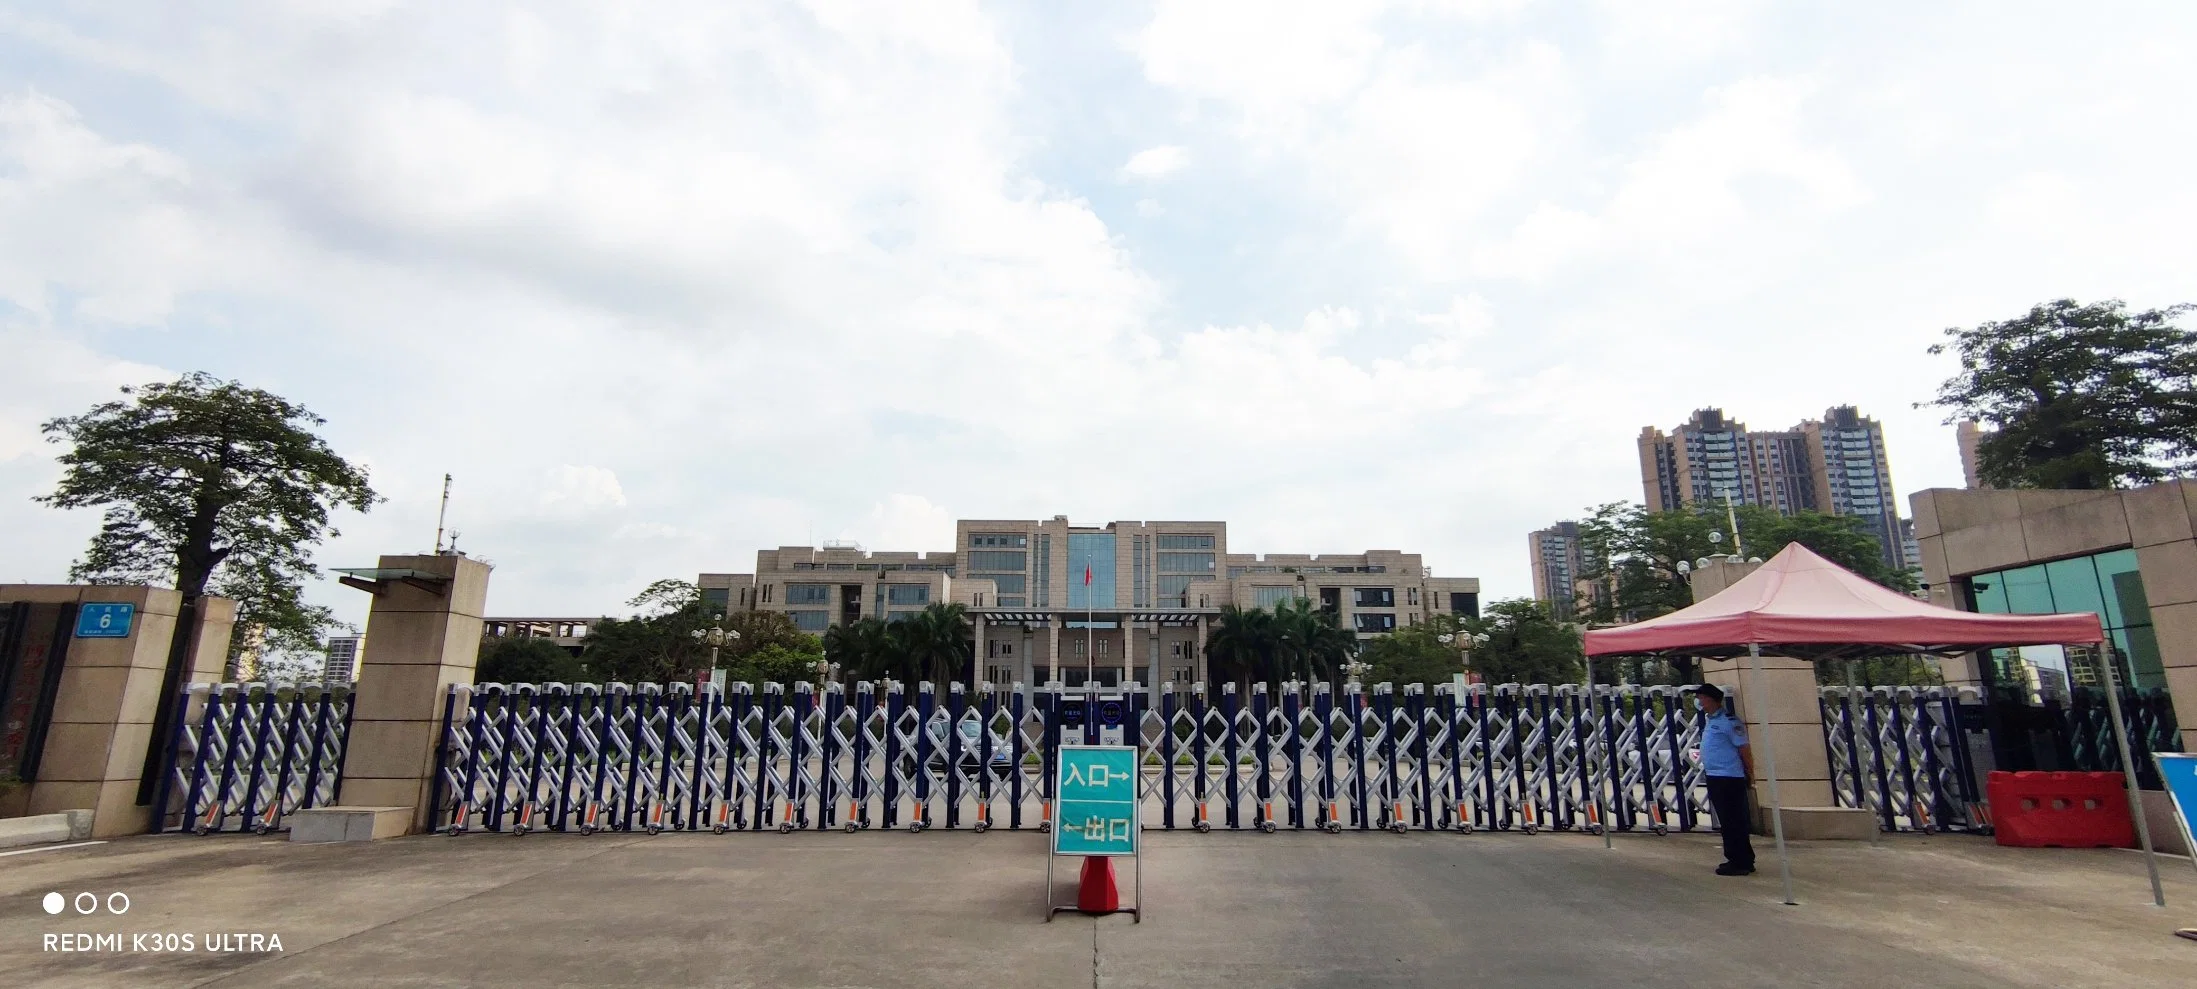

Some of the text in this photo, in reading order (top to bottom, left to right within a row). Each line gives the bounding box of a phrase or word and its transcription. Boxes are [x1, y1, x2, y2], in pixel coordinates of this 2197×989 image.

[100, 614, 112, 629] 6
[1063, 762, 1109, 788] 入口
[1084, 815, 1130, 842] 出口
